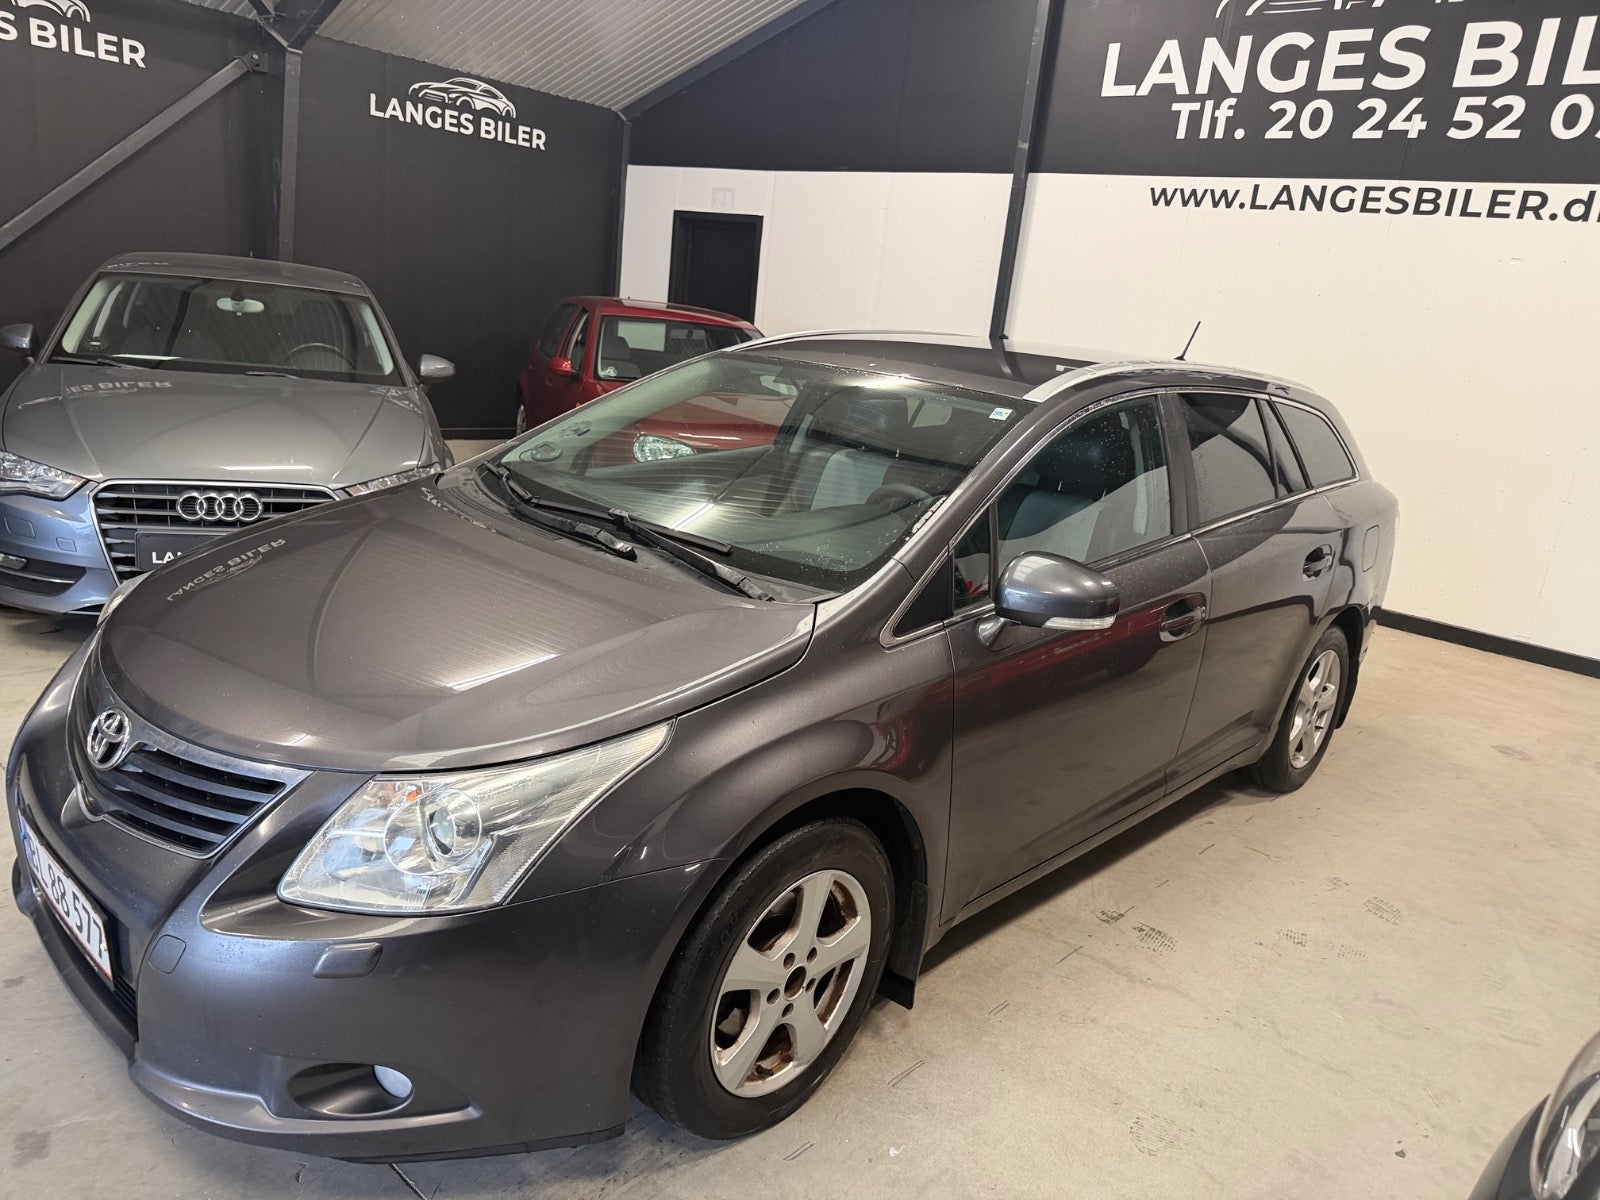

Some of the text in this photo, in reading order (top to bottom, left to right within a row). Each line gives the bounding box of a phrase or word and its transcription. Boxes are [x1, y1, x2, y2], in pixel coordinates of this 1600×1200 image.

[29, 17, 147, 69] BILER
[1101, 25, 1431, 97] LANGES
[369, 93, 546, 151] LANGES BILER
[1171, 93, 1600, 140] Tlf. 20 24 52 0
[1150, 183, 1600, 223] www.LANGESBILER.d
[152, 551, 183, 564] LA
[48, 863, 70, 918] 88
[72, 890, 103, 960] 577
